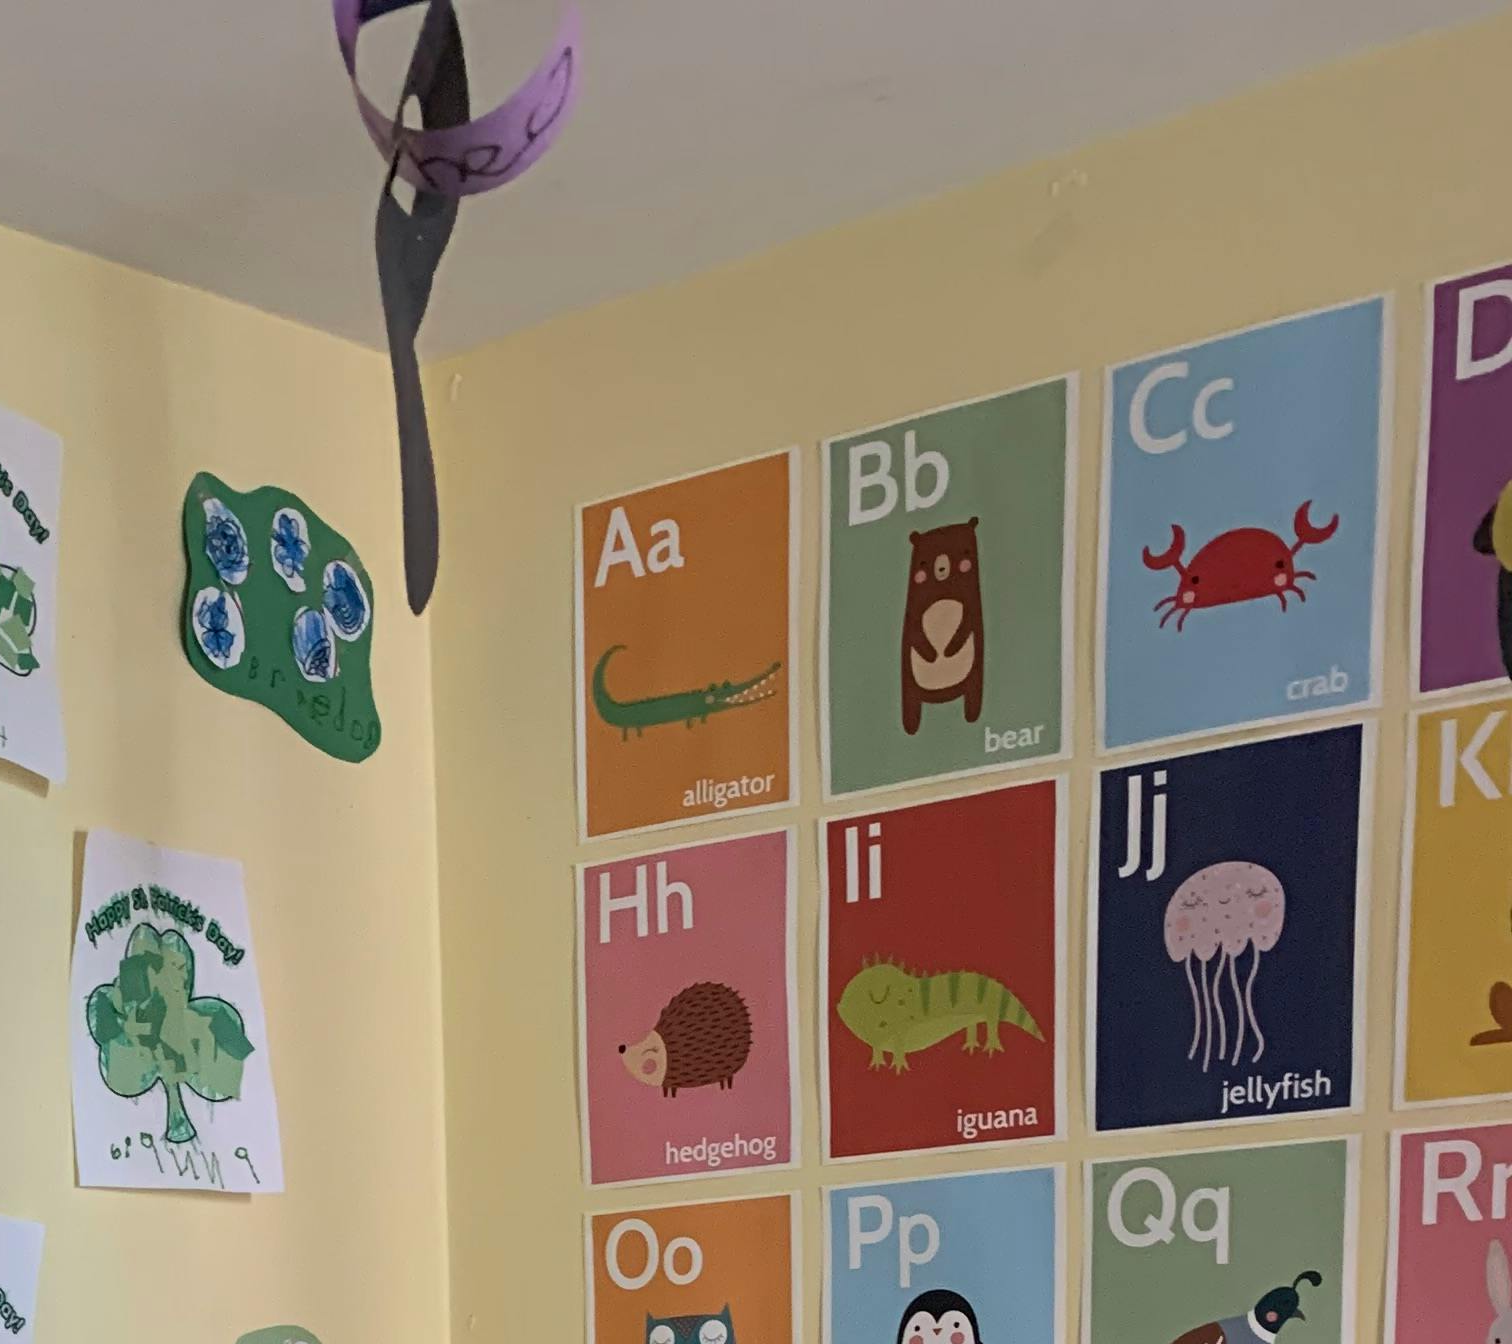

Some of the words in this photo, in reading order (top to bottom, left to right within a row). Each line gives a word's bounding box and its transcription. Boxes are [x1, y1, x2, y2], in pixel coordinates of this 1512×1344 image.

[1455, 280, 1512, 381] D
[1129, 361, 1236, 456] Cc
[13, 490, 51, 544] Day!
[847, 428, 950, 528] Bb
[593, 506, 684, 588] Aa
[1287, 665, 1348, 701] crab
[984, 722, 1045, 754] bear
[1437, 710, 1512, 808] K
[682, 771, 776, 811] alligator
[1118, 769, 1169, 882] Jj
[598, 860, 695, 945] Hh
[844, 821, 883, 903] Ii
[85, 894, 131, 948] Happy
[131, 886, 150, 911] St.
[149, 884, 205, 932] Patrick's
[205, 918, 246, 965] Day!
[956, 1103, 1038, 1141] iguana
[1221, 1069, 1333, 1113] jellyfish
[665, 1132, 777, 1169] hedgehog
[1420, 1139, 1512, 1227] Rr
[604, 1217, 704, 1292] Oo
[847, 1194, 941, 1290] Pp
[1106, 1165, 1231, 1266] Qq
